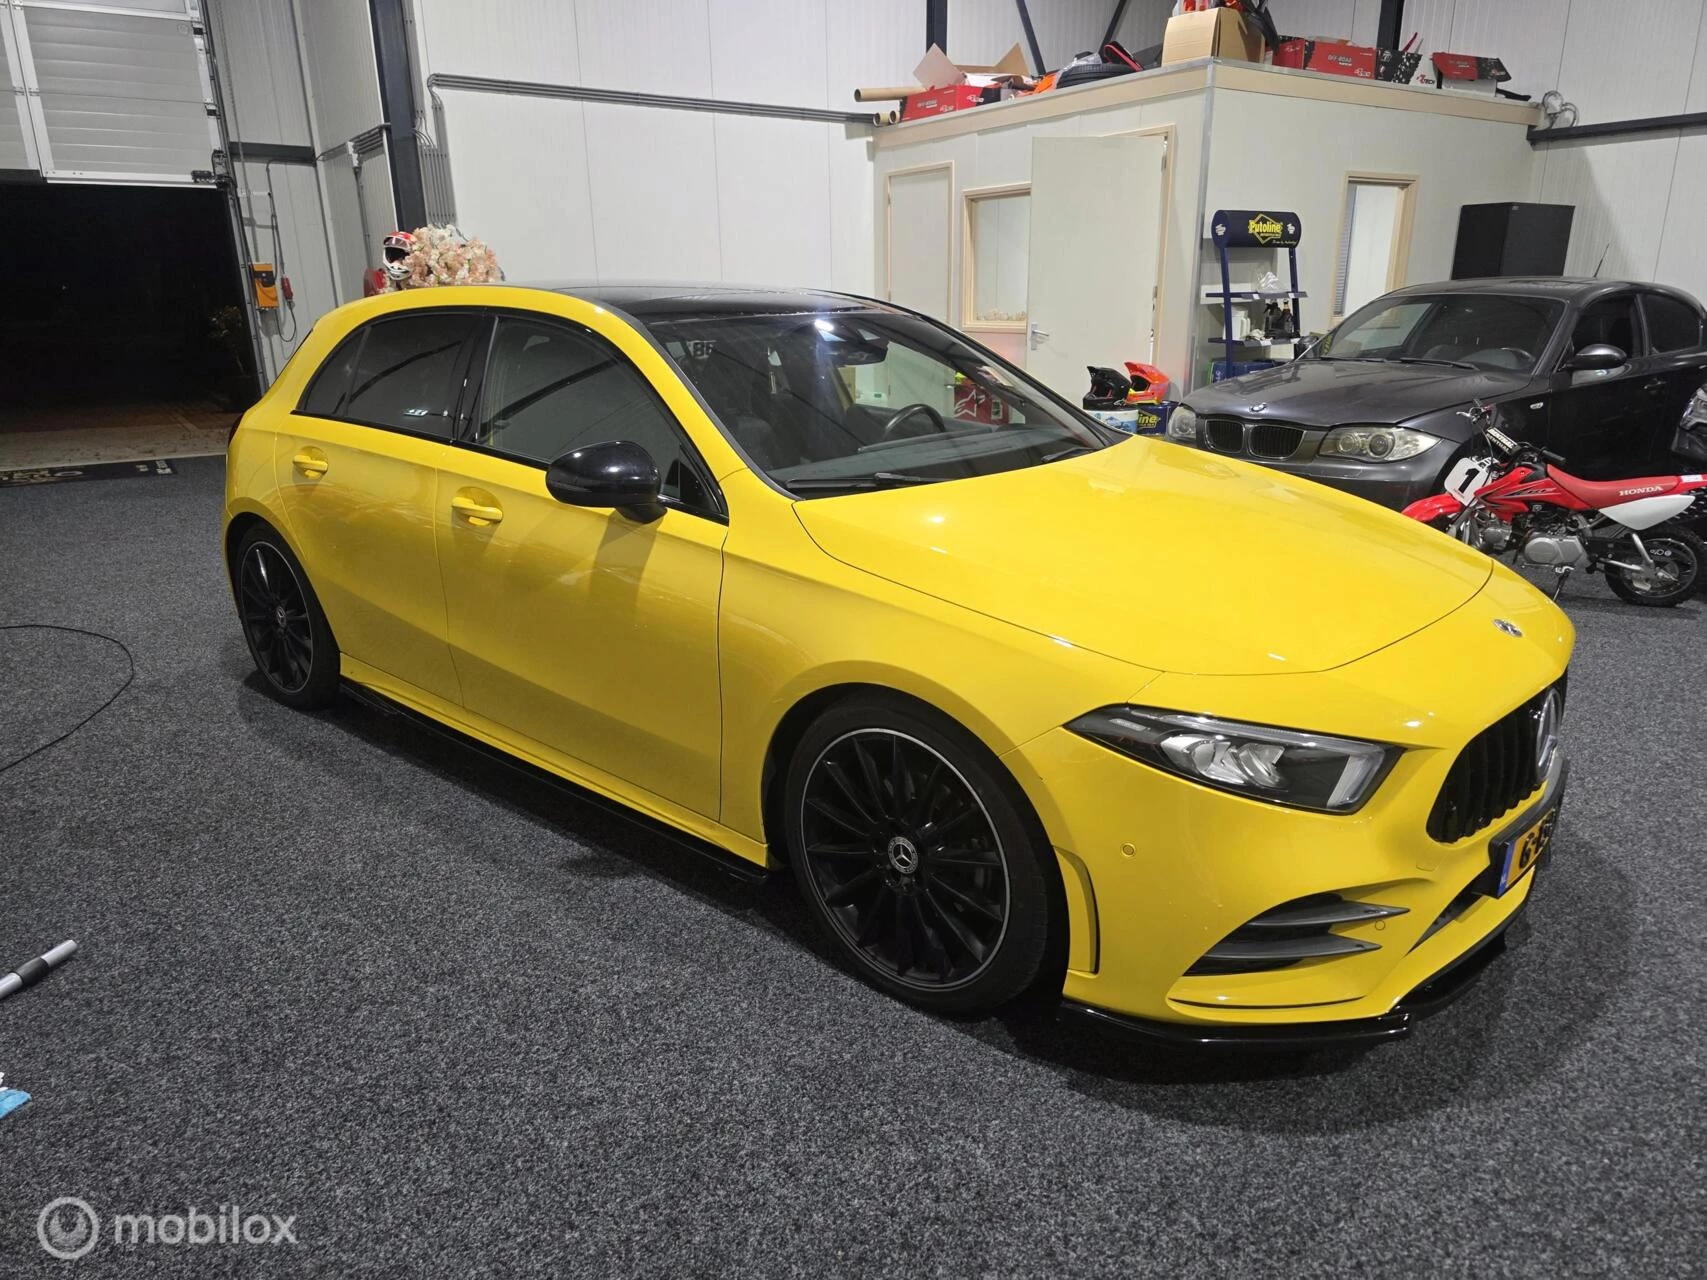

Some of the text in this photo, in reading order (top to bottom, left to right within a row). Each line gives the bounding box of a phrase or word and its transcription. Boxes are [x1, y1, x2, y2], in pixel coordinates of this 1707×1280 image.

[1249, 220, 1282, 234] Putoline
[1459, 467, 1481, 494] 1
[1618, 485, 1664, 497] HONDA
